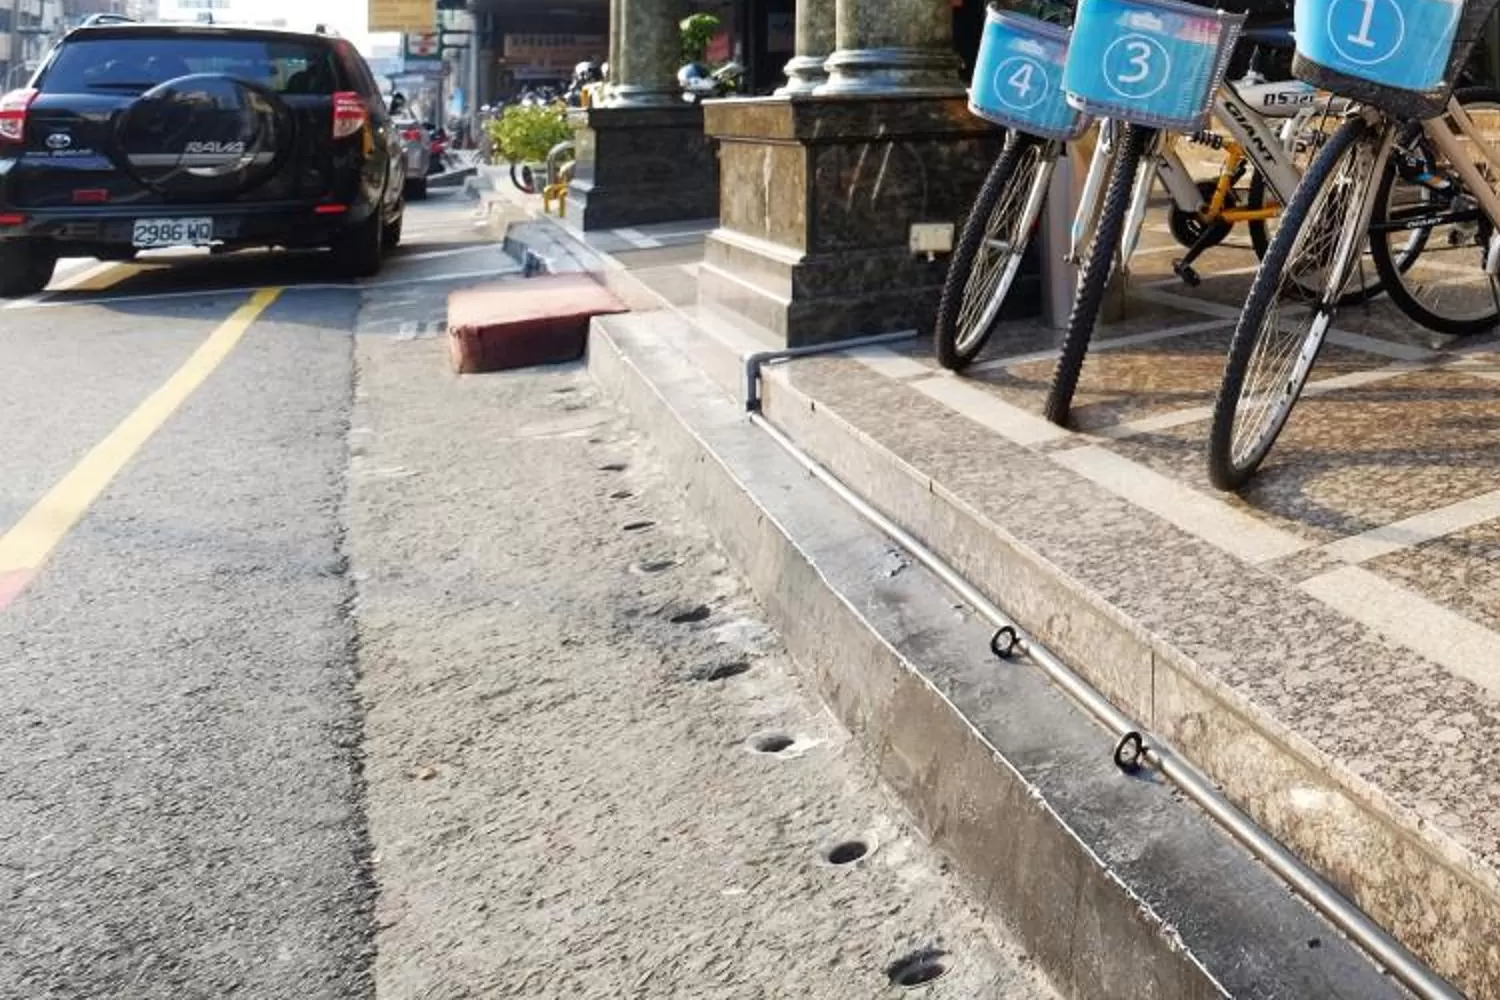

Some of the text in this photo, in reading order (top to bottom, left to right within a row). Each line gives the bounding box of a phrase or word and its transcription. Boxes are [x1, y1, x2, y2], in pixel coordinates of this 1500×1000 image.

[1007, 63, 1034, 98] 4
[1117, 41, 1152, 84] 3
[1225, 101, 1278, 165] GIANT
